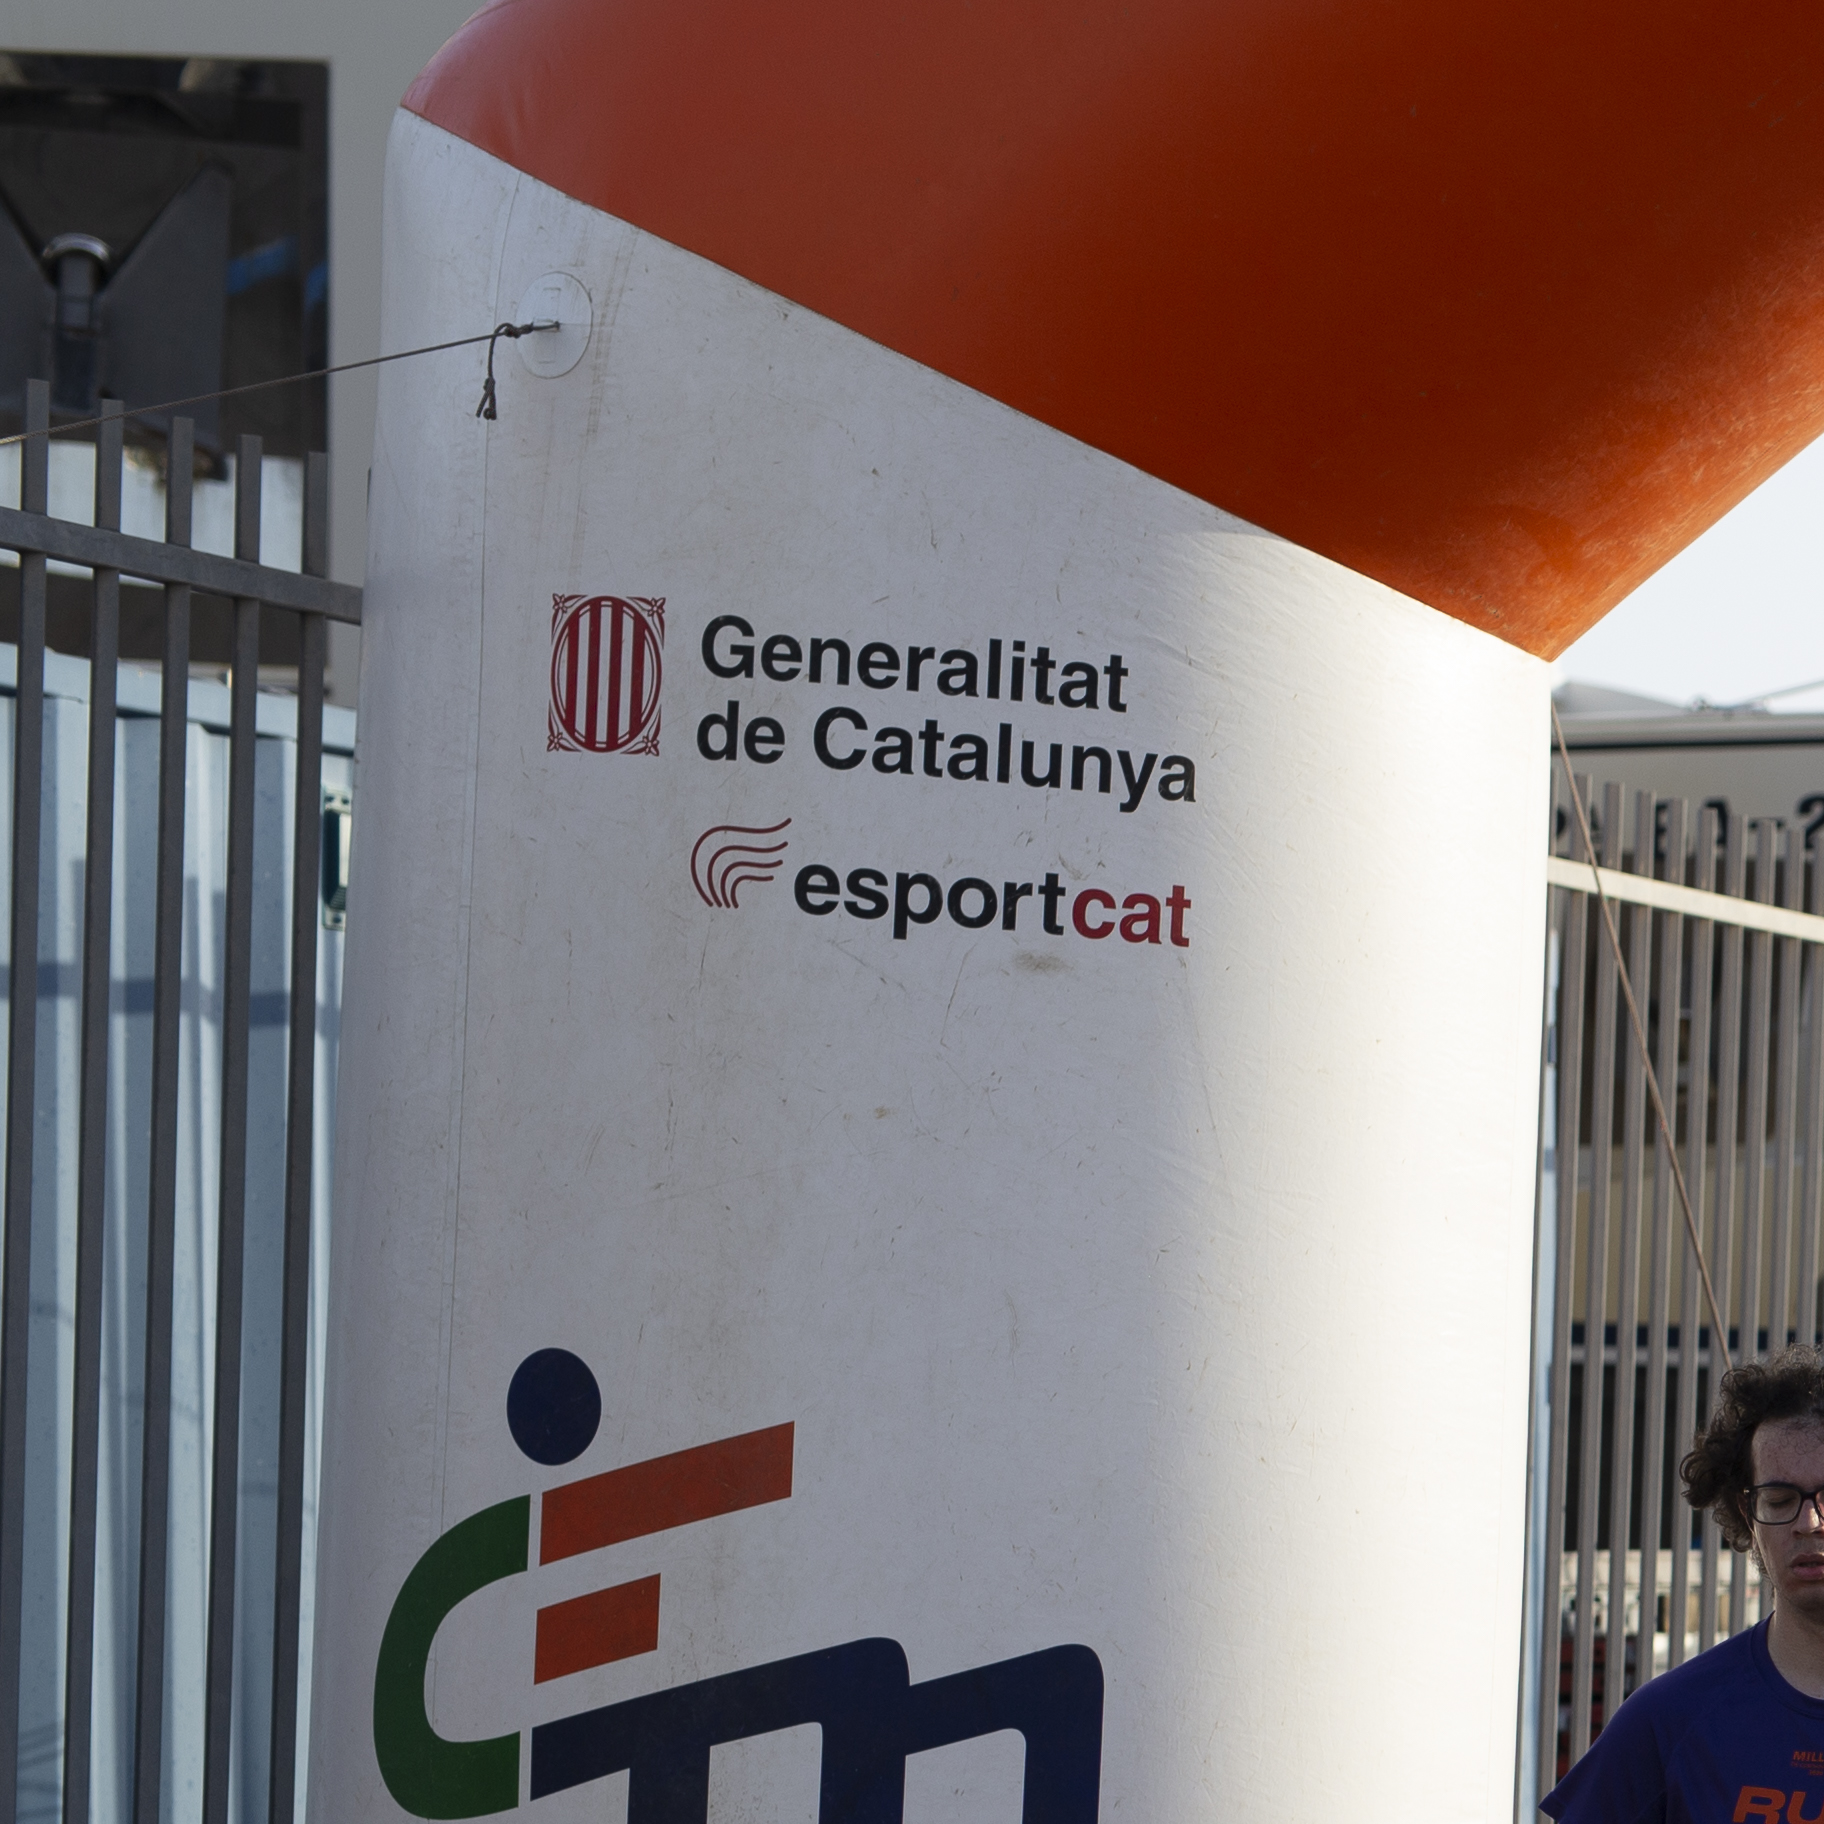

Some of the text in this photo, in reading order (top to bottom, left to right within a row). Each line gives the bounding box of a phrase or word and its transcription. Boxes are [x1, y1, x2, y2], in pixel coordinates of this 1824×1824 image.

[701, 614, 1129, 712] Generalitat
[697, 700, 1197, 813] de Catalunya
[794, 863, 1192, 948] esportcat
